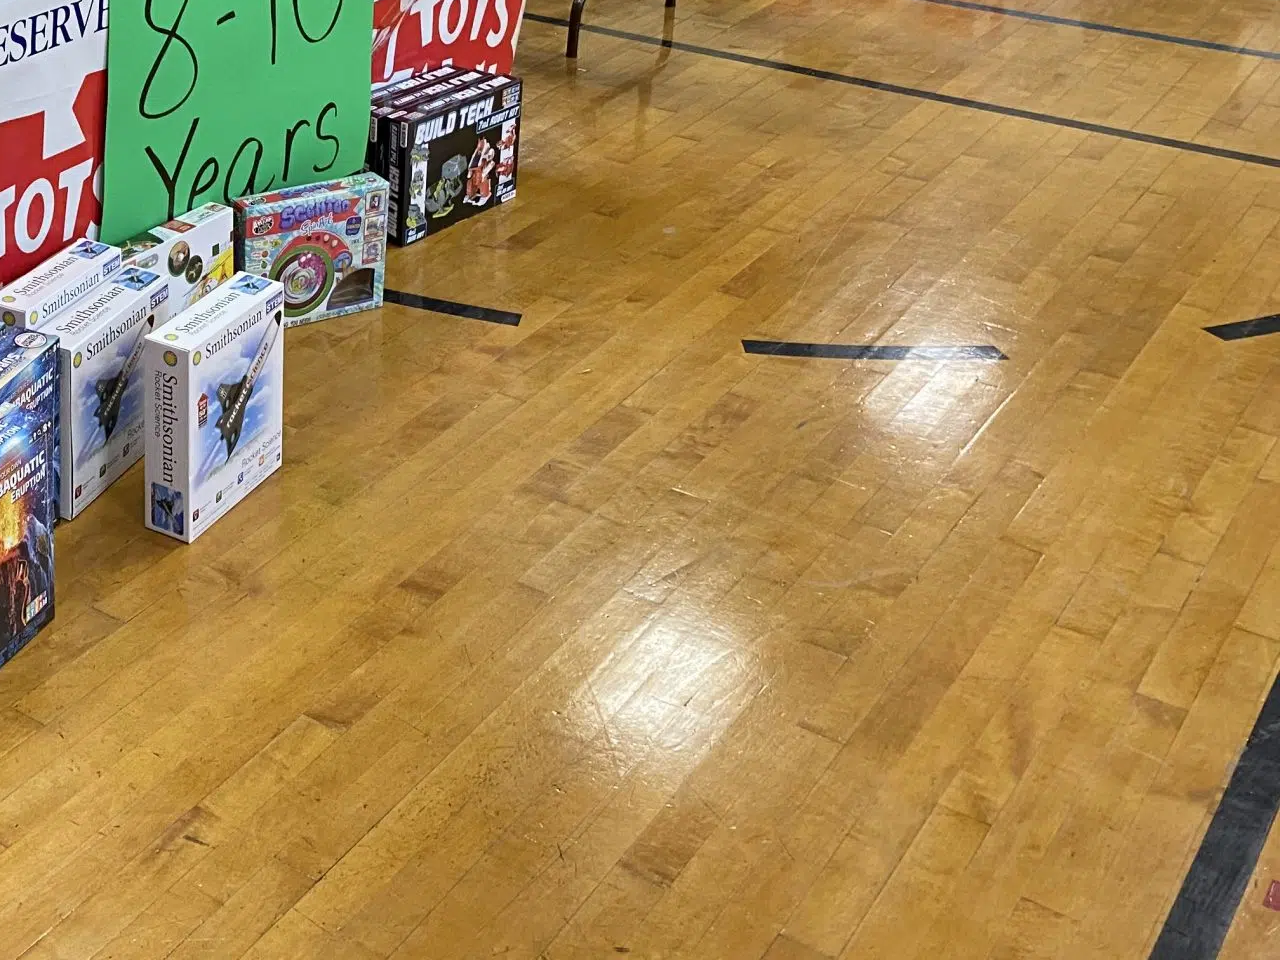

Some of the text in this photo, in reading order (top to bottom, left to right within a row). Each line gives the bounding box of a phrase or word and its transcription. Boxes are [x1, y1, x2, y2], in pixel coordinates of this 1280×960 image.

[415, 96, 495, 144] BUILD TECH
[144, 102, 340, 220] Years
[102, 258, 120, 276] STEM
[41, 273, 100, 319] Smithsonian
[150, 291, 169, 310] STEM
[265, 296, 283, 313] STEM
[86, 306, 147, 360] Smithsonian
[204, 310, 262, 360] Smithsonian
[154, 370, 162, 438] Rocket Science
[160, 372, 178, 484] Smithsonian
[10, 466, 46, 504] ERUPTION
